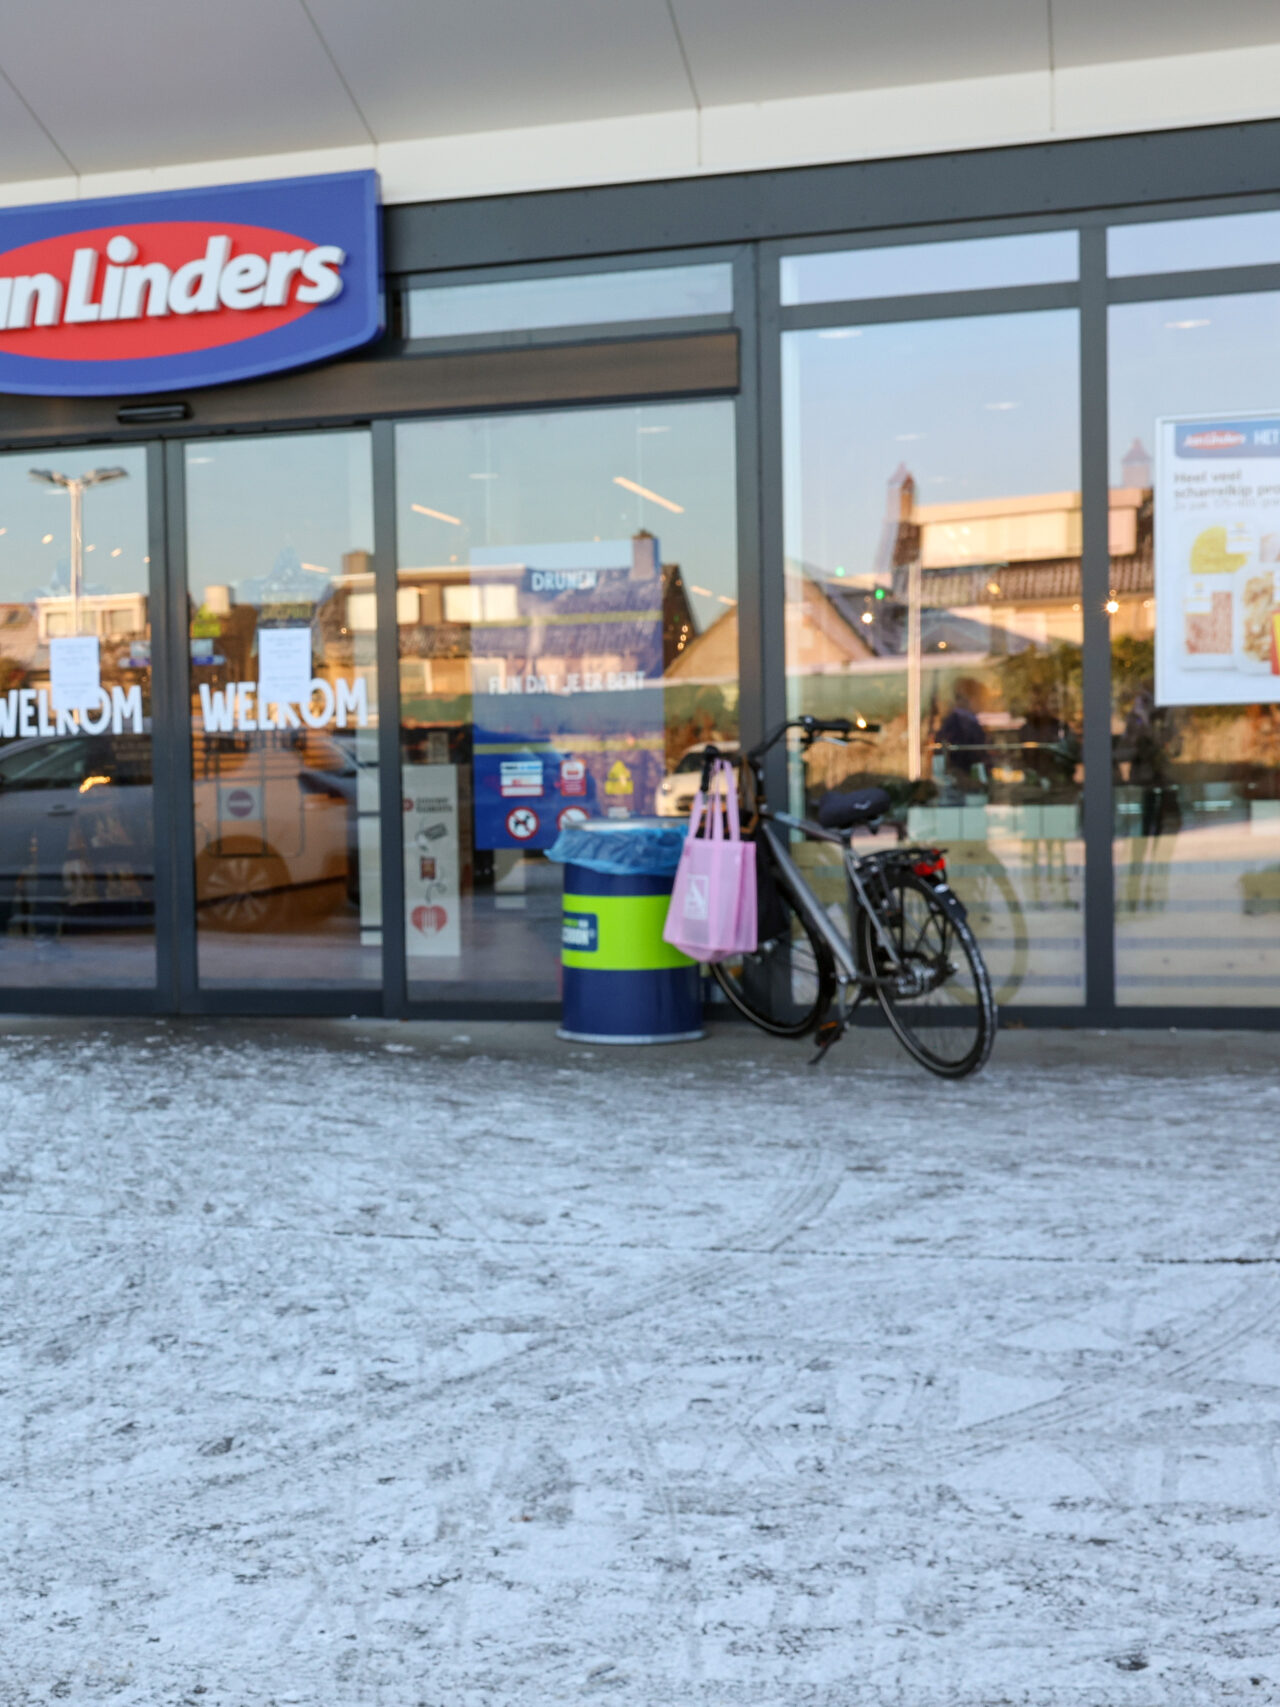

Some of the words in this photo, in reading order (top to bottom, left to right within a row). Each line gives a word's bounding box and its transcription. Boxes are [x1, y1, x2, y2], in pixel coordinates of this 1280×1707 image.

[63, 235, 346, 323] Linders
[531, 571, 597, 591] DRUNEN
[525, 674, 557, 694] DAT
[563, 673, 581, 692] JE
[584, 672, 604, 691] ER
[607, 670, 646, 690] BENT
[199, 677, 368, 732] WELKOM
